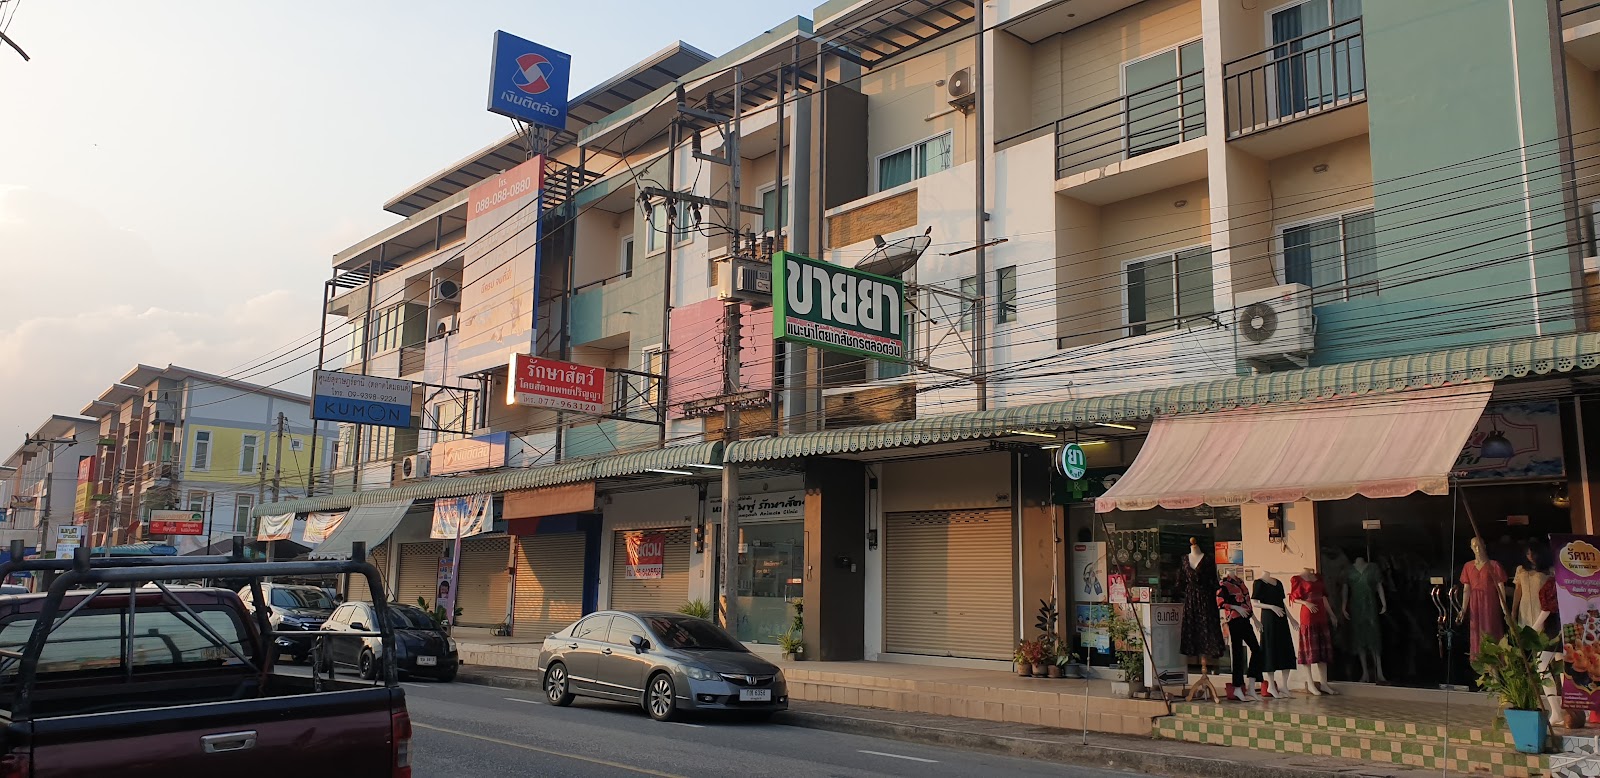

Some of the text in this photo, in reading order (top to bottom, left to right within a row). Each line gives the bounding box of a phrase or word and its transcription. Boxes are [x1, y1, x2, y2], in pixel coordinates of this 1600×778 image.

[501, 90, 559, 117] เงินติดล้อ
[475, 177, 531, 214] 088-088-0880
[786, 259, 901, 336] ขายยา
[787, 323, 901, 358] แนะนำโดยเภสัชกรตลอดวัน
[527, 358, 596, 387] รักษาสัตว์
[347, 391, 397, 403] 09-9398-9224
[519, 378, 601, 402] โดยสัตวแพทย์ปริญญา
[325, 401, 400, 421] KUMON
[522, 394, 597, 413] โทร. 077-963120
[1067, 448, 1084, 466] ยา
[1157, 609, 1180, 622] อ.เภสัช
